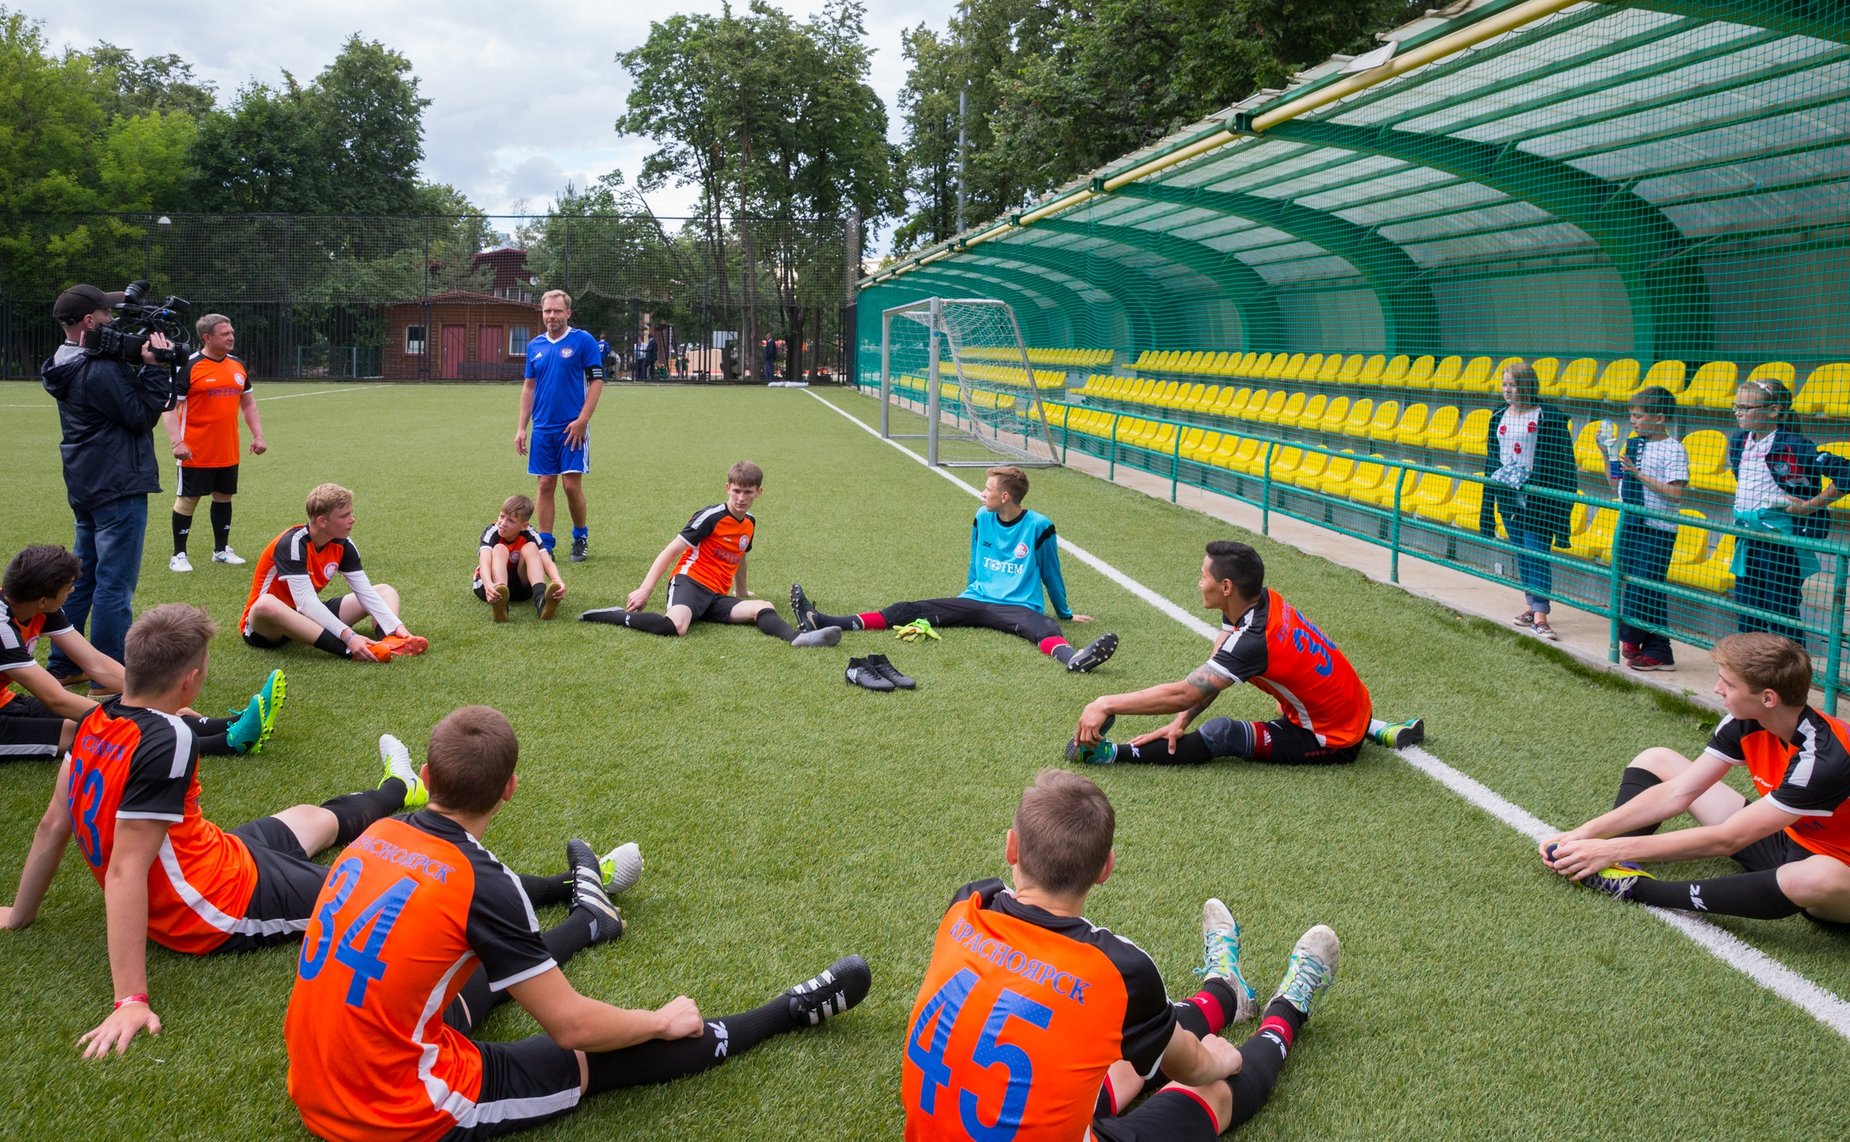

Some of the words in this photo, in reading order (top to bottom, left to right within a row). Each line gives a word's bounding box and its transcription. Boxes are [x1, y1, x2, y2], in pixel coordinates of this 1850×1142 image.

[298, 856, 420, 1009] 34
[949, 916, 1093, 1006] КРАСНОЯРСК
[907, 966, 1055, 1142] 45
